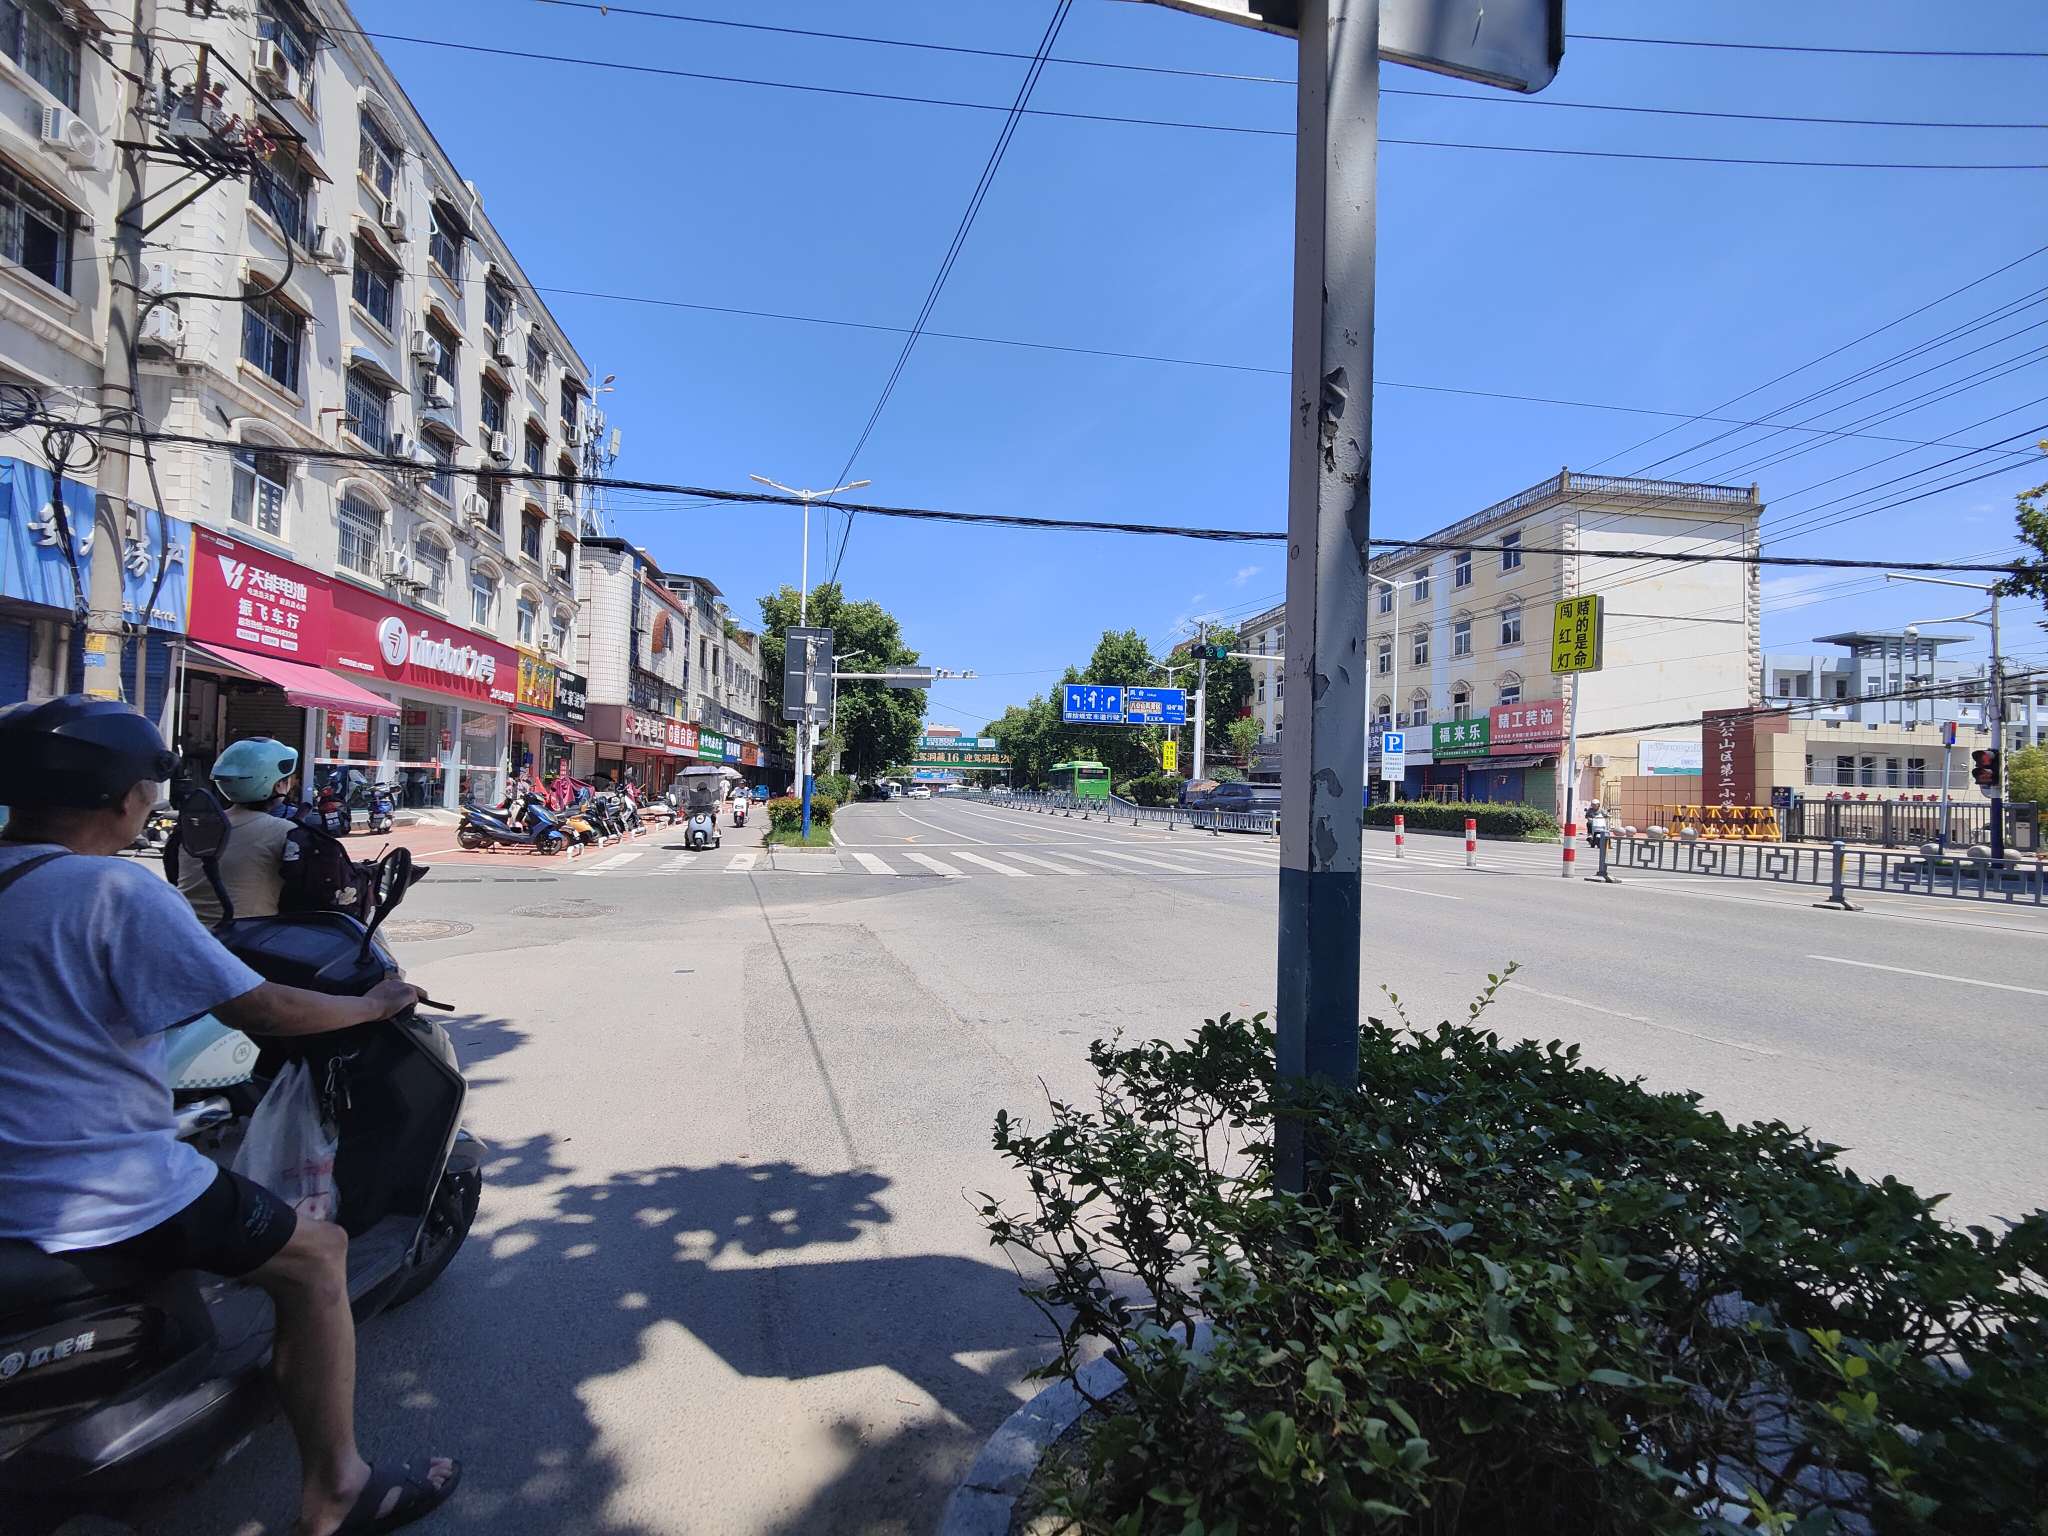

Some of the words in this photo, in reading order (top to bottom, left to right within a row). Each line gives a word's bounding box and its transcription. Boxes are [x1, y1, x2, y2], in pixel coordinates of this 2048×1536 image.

[248, 566, 307, 602] 天能电池
[1557, 603, 1573, 669] 闯红灯
[1574, 600, 1590, 667] 赌的是命
[1440, 723, 1481, 744] 福来乐
[1498, 709, 1553, 729] 精工装饰
